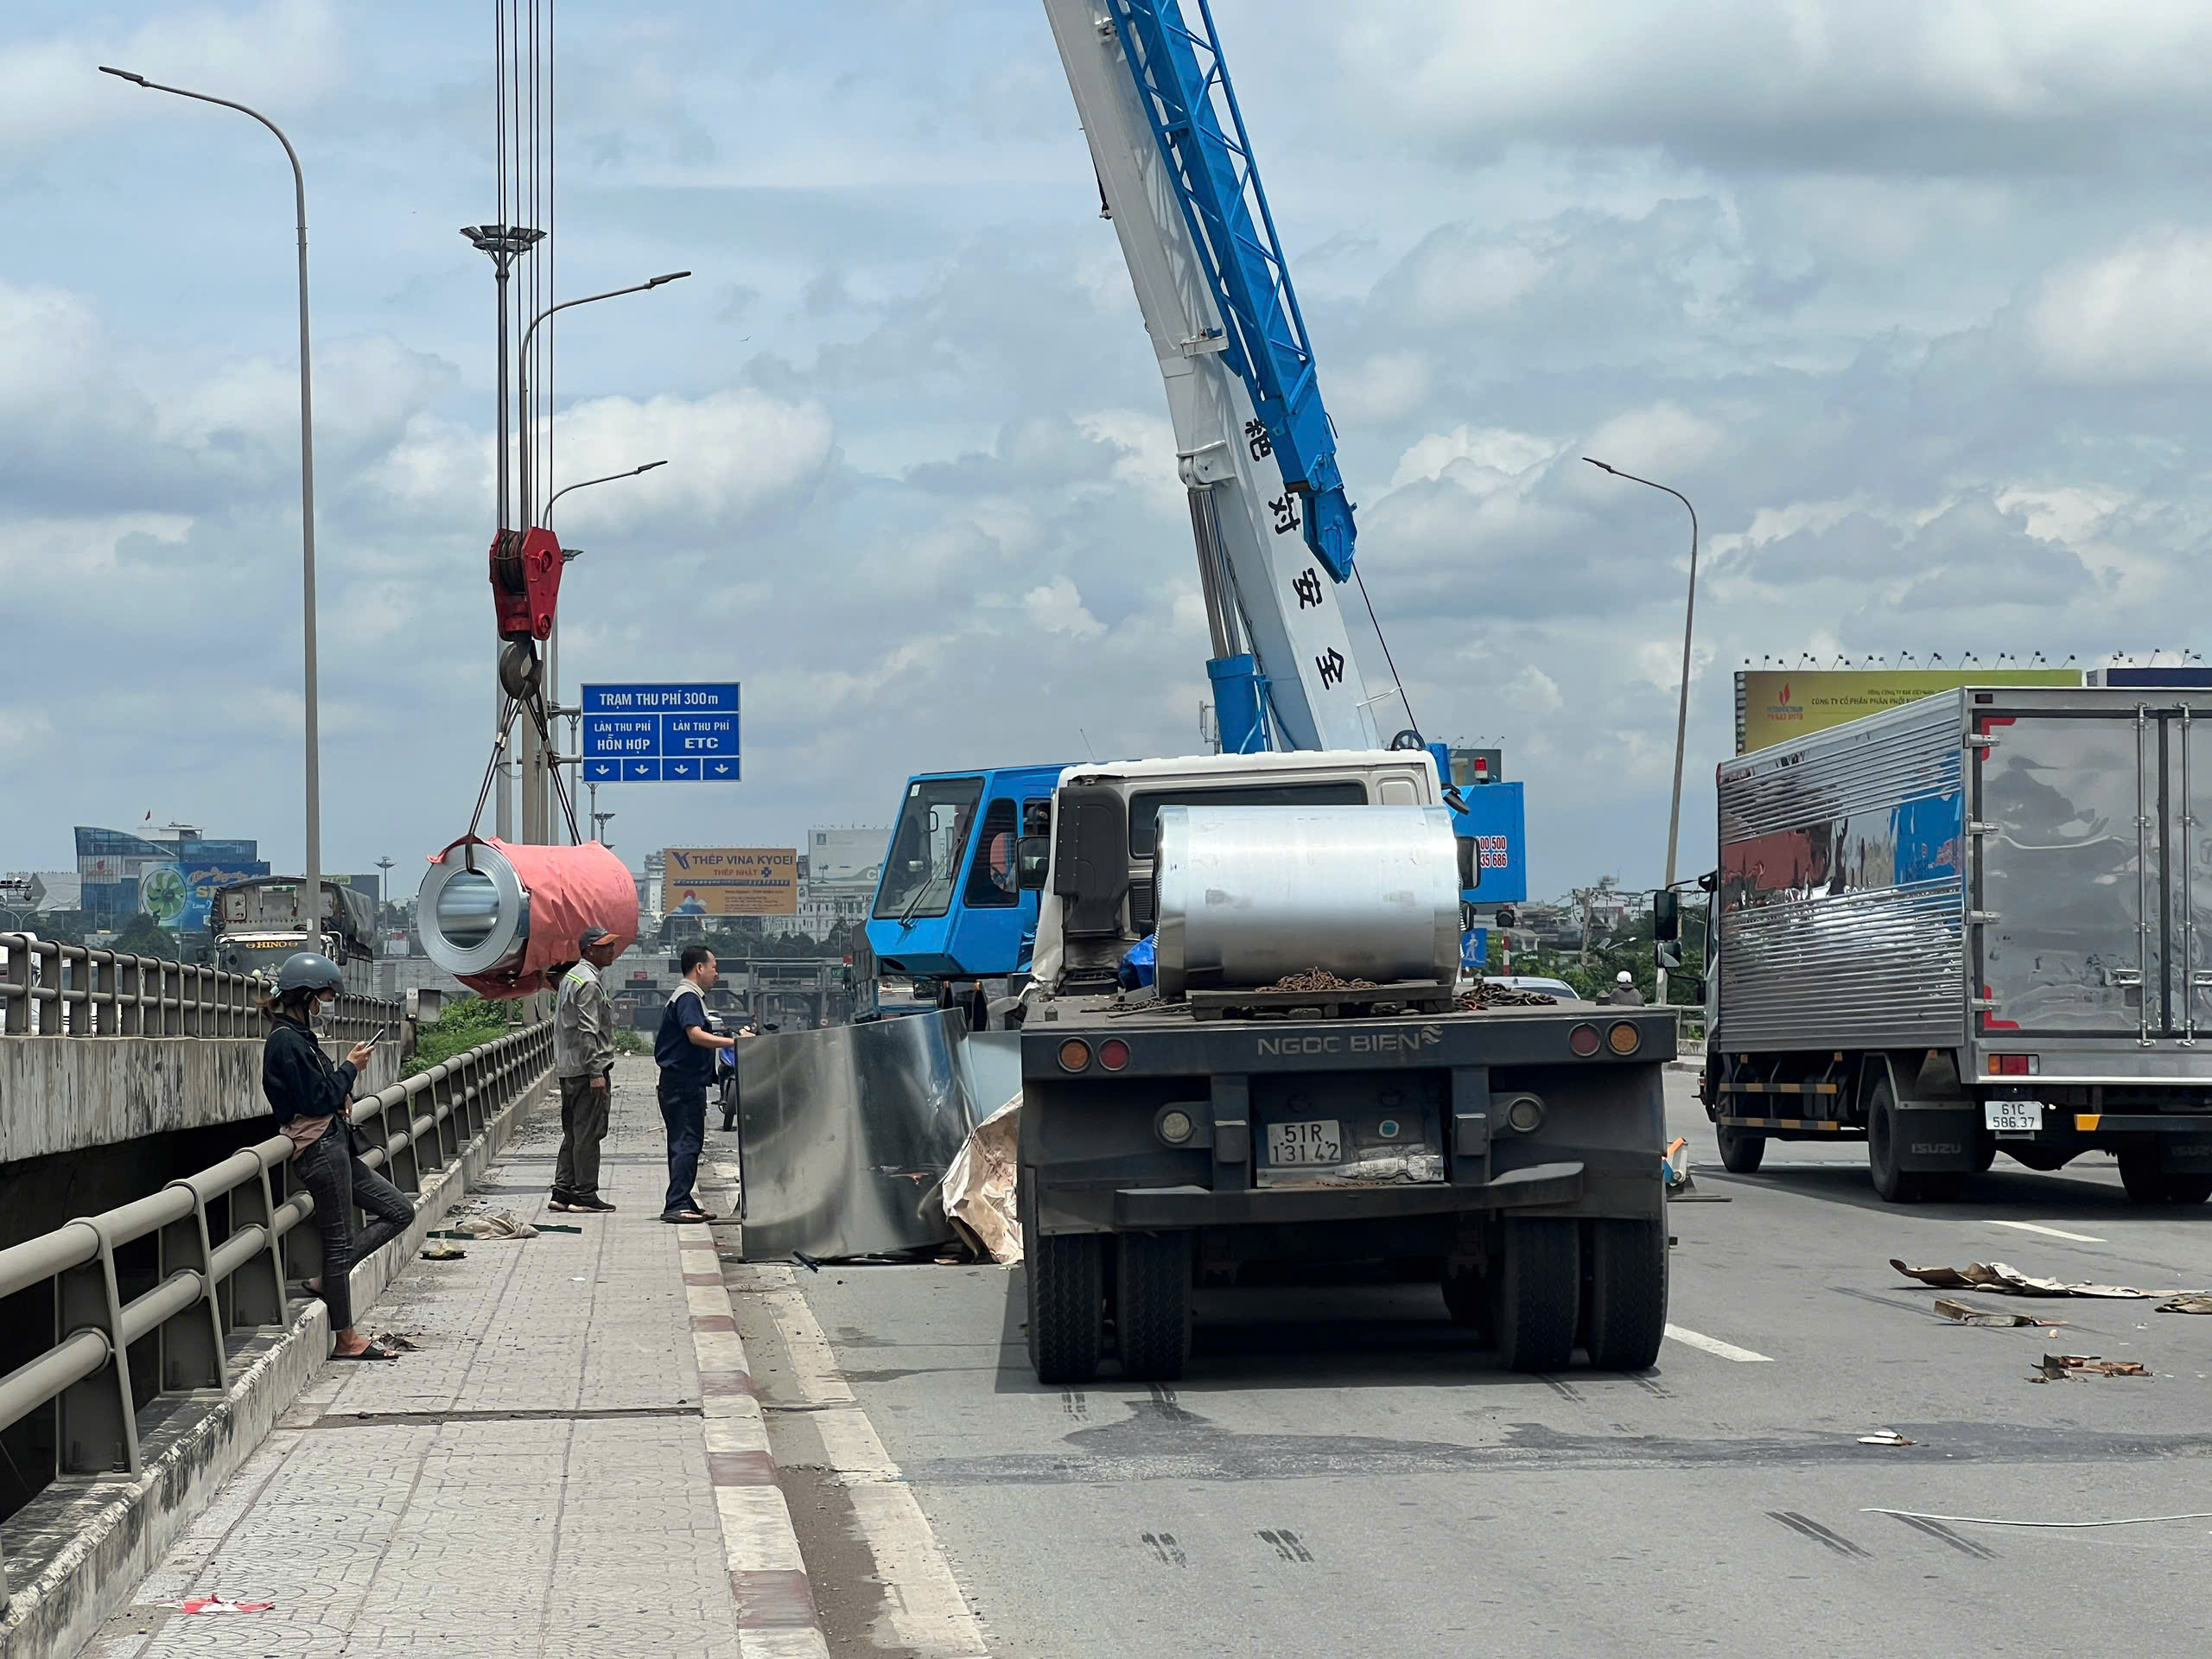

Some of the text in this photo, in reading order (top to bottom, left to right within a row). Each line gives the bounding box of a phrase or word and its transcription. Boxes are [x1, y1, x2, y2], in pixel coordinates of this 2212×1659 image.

[600, 693, 632, 709] TRẠM
[636, 693, 658, 705] THU
[662, 690, 682, 705] PHÍ
[594, 720, 651, 732] LÀN THU PHÍ
[672, 719, 729, 731] LÀN THU PHÍ
[597, 734, 650, 753] HỖN HỢP
[684, 737, 719, 749] ETC
[1480, 836, 1506, 850] 00 500
[692, 854, 793, 865] THÉP VINA KYOEI
[1492, 853, 1507, 867] 686
[257, 940, 288, 949] HINO
[2001, 1103, 2025, 1115] 61C
[1993, 1116, 2034, 1128] 586.37
[1285, 1123, 1322, 1143] 51R
[1273, 1142, 1339, 1163] 131.42
[1910, 1142, 1962, 1154] ISUZU
